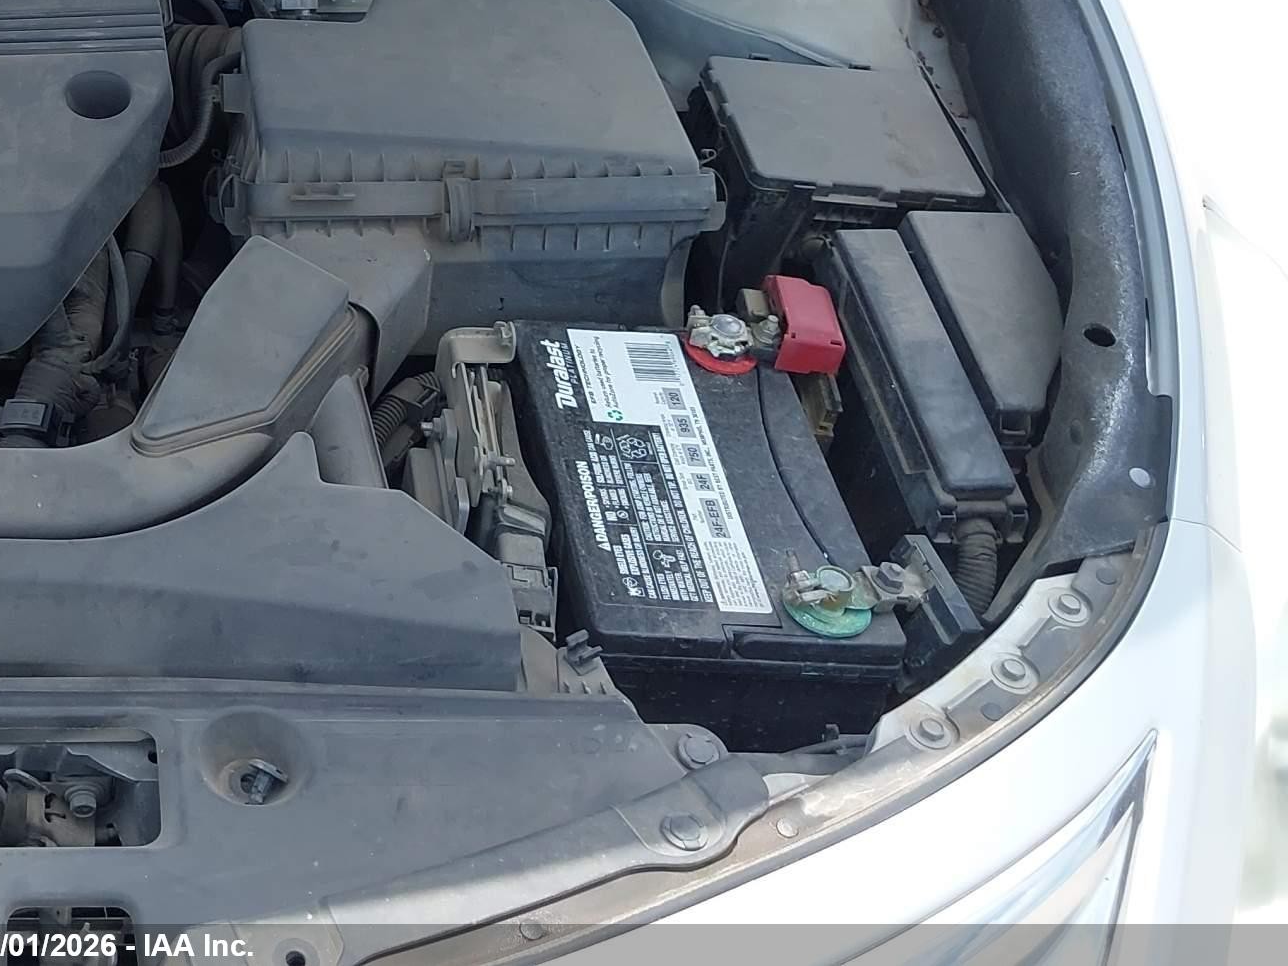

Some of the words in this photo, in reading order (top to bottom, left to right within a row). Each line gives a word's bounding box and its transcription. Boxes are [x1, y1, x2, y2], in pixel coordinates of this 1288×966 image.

[561, 343, 578, 384] PLATINUM
[575, 345, 591, 388] TECHNOLOGY
[540, 339, 577, 408] Duralast
[588, 391, 596, 404] EFB
[603, 391, 612, 408] Return
[608, 384, 619, 408] AutoZone
[668, 392, 681, 405] 120
[677, 419, 690, 432] 935
[687, 447, 700, 461] 750
[696, 474, 710, 490] 24F
[575, 461, 608, 541] DANGER/POISON
[670, 490, 680, 499] NOT
[605, 511, 617, 521] NO
[705, 500, 726, 537] 24F-EFB
[613, 545, 624, 557] EYES
[688, 542, 699, 558] REACH
[698, 578, 709, 589] OUT
[702, 590, 713, 602] KEEP
